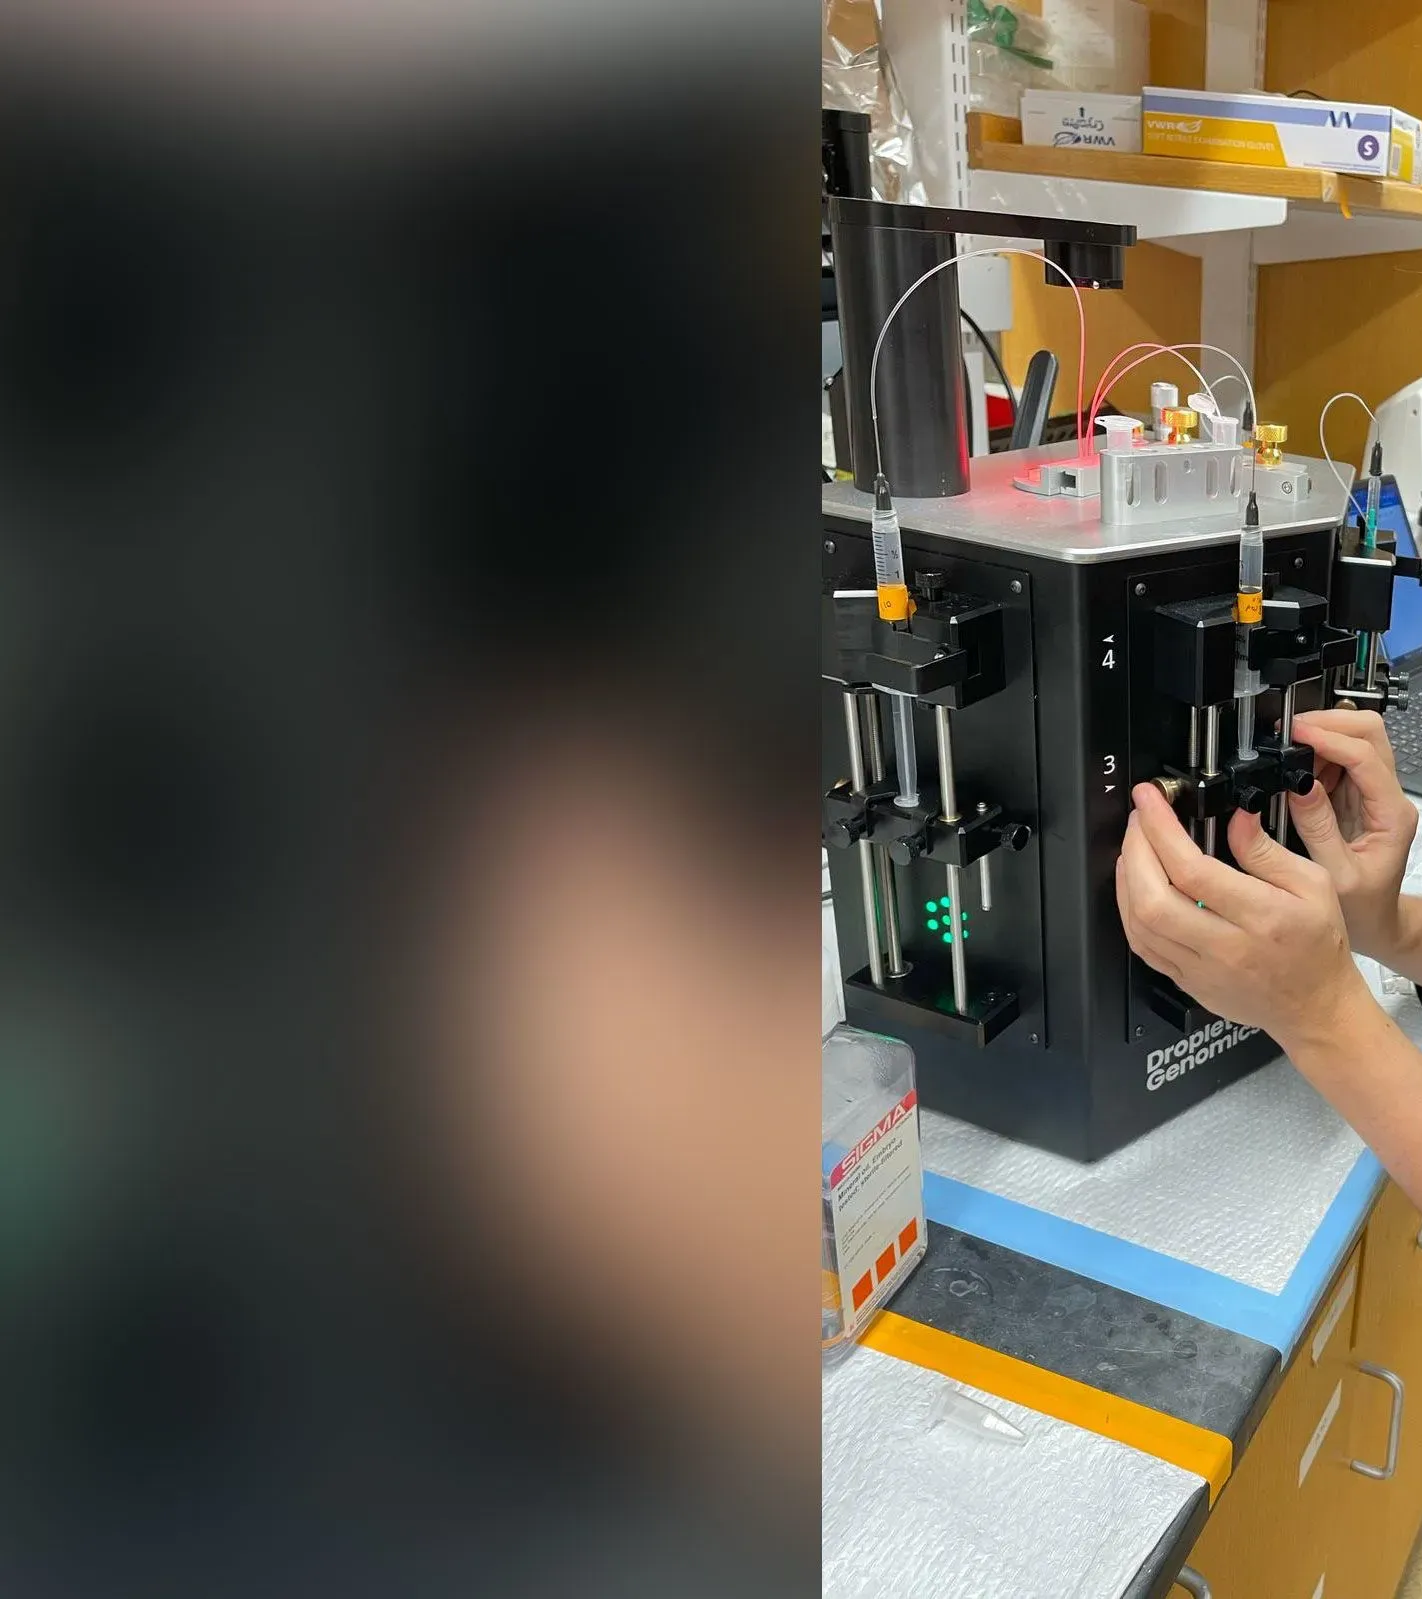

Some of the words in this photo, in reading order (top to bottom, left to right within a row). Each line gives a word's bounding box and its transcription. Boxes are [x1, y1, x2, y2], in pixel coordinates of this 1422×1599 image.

[1147, 119, 1176, 130] VWR
[1083, 133, 1116, 147] VWR
[1101, 649, 1116, 669] 4
[1103, 755, 1116, 775] 3
[841, 1103, 906, 1177] SIGMA
